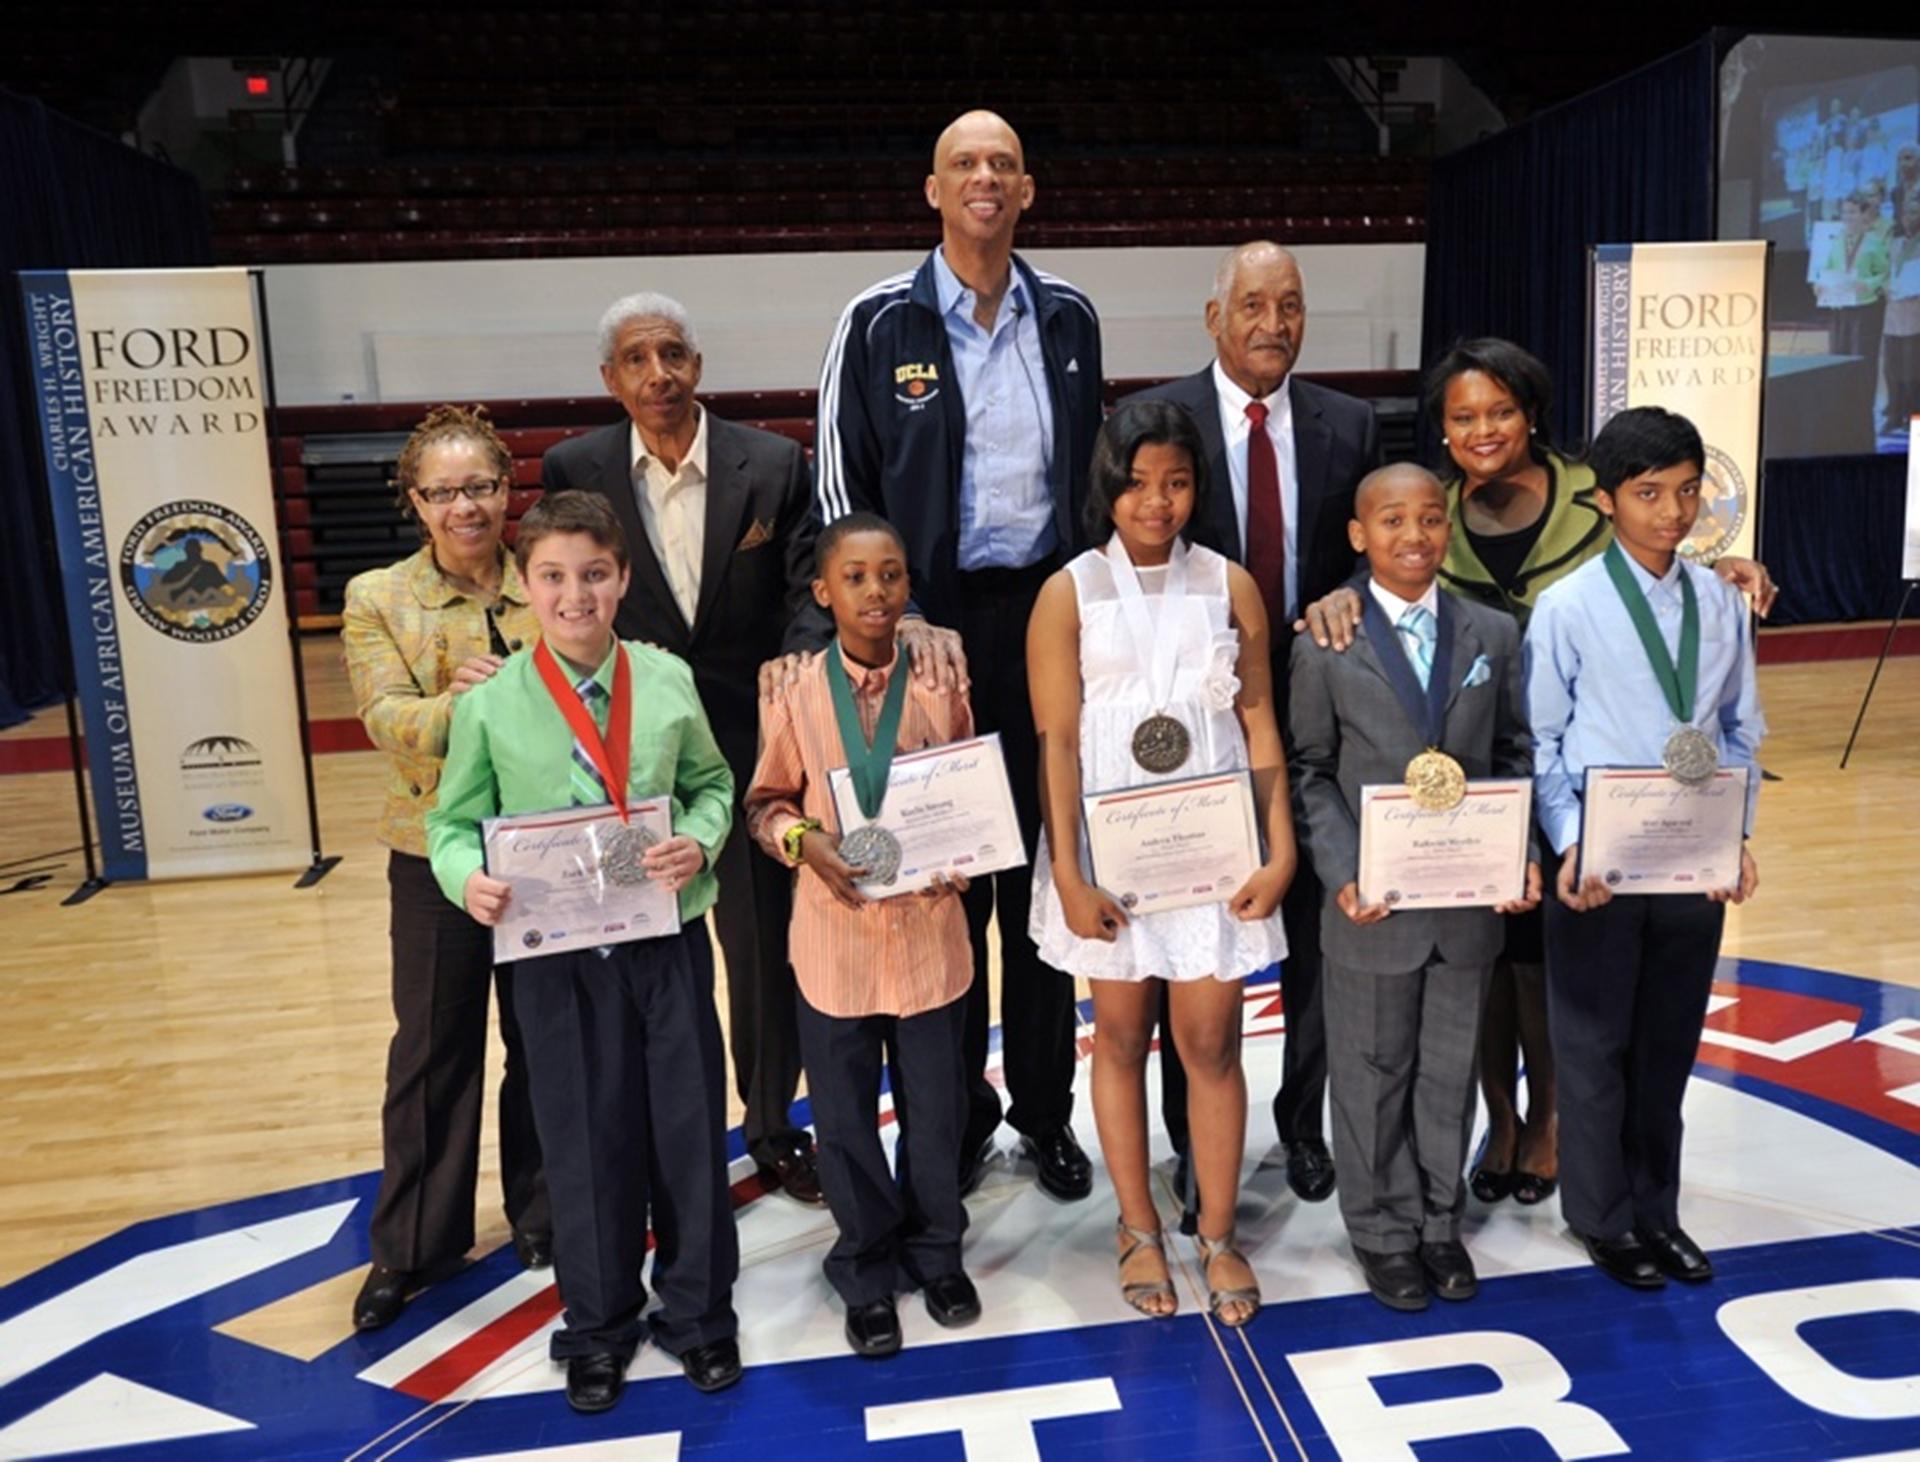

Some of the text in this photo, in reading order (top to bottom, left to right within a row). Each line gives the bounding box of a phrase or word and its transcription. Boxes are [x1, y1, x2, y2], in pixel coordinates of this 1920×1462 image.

[31, 293, 54, 368] WRIGHT
[1611, 265, 1628, 368] HISTORY
[1637, 292, 1758, 330] FORD
[88, 326, 250, 370] FORD
[1635, 336, 1756, 359] FREEDOM
[93, 376, 255, 404] FREEDOM
[895, 363, 939, 383] UCLA
[1632, 367, 1756, 388] AWARD
[46, 396, 69, 472] CHARLES
[97, 412, 259, 437] AWARD
[122, 501, 268, 564] FORD FREEDOM AWARD
[49, 293, 143, 852] MUSEUM OF AFRICAN AMERICAN HISTORY
